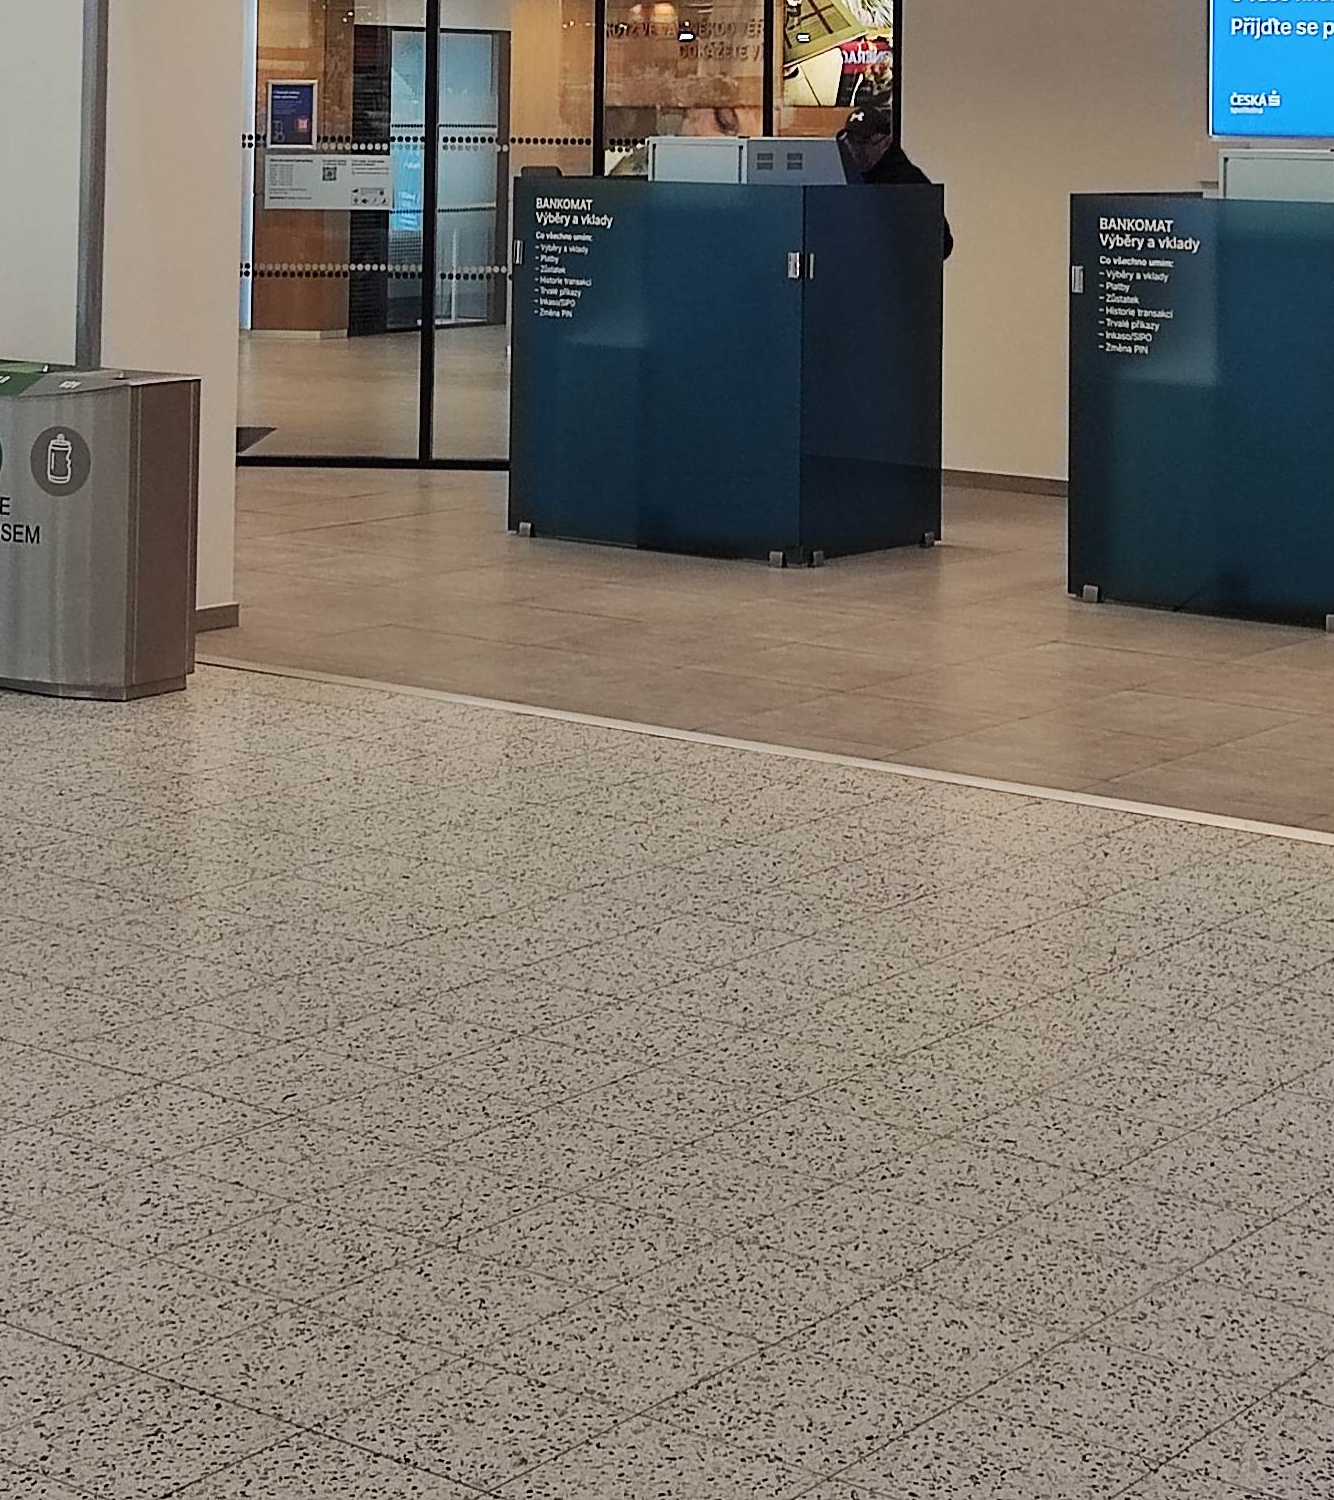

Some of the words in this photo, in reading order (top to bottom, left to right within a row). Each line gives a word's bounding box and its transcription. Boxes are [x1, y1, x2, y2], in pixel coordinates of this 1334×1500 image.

[1231, 17, 1292, 39] Přijďte
[1296, 21, 1319, 35] se
[1229, 91, 1267, 106] ČESKÁ
[535, 197, 593, 211] BANKOMAT
[535, 211, 571, 227] Výběry
[572, 215, 579, 225] a
[580, 213, 614, 229] vklady
[1099, 217, 1174, 233] BANKOMAT
[1099, 232, 1144, 251] Výběry
[1147, 237, 1155, 248] a
[1157, 236, 1201, 254] vklady
[1099, 256, 1111, 265] Co
